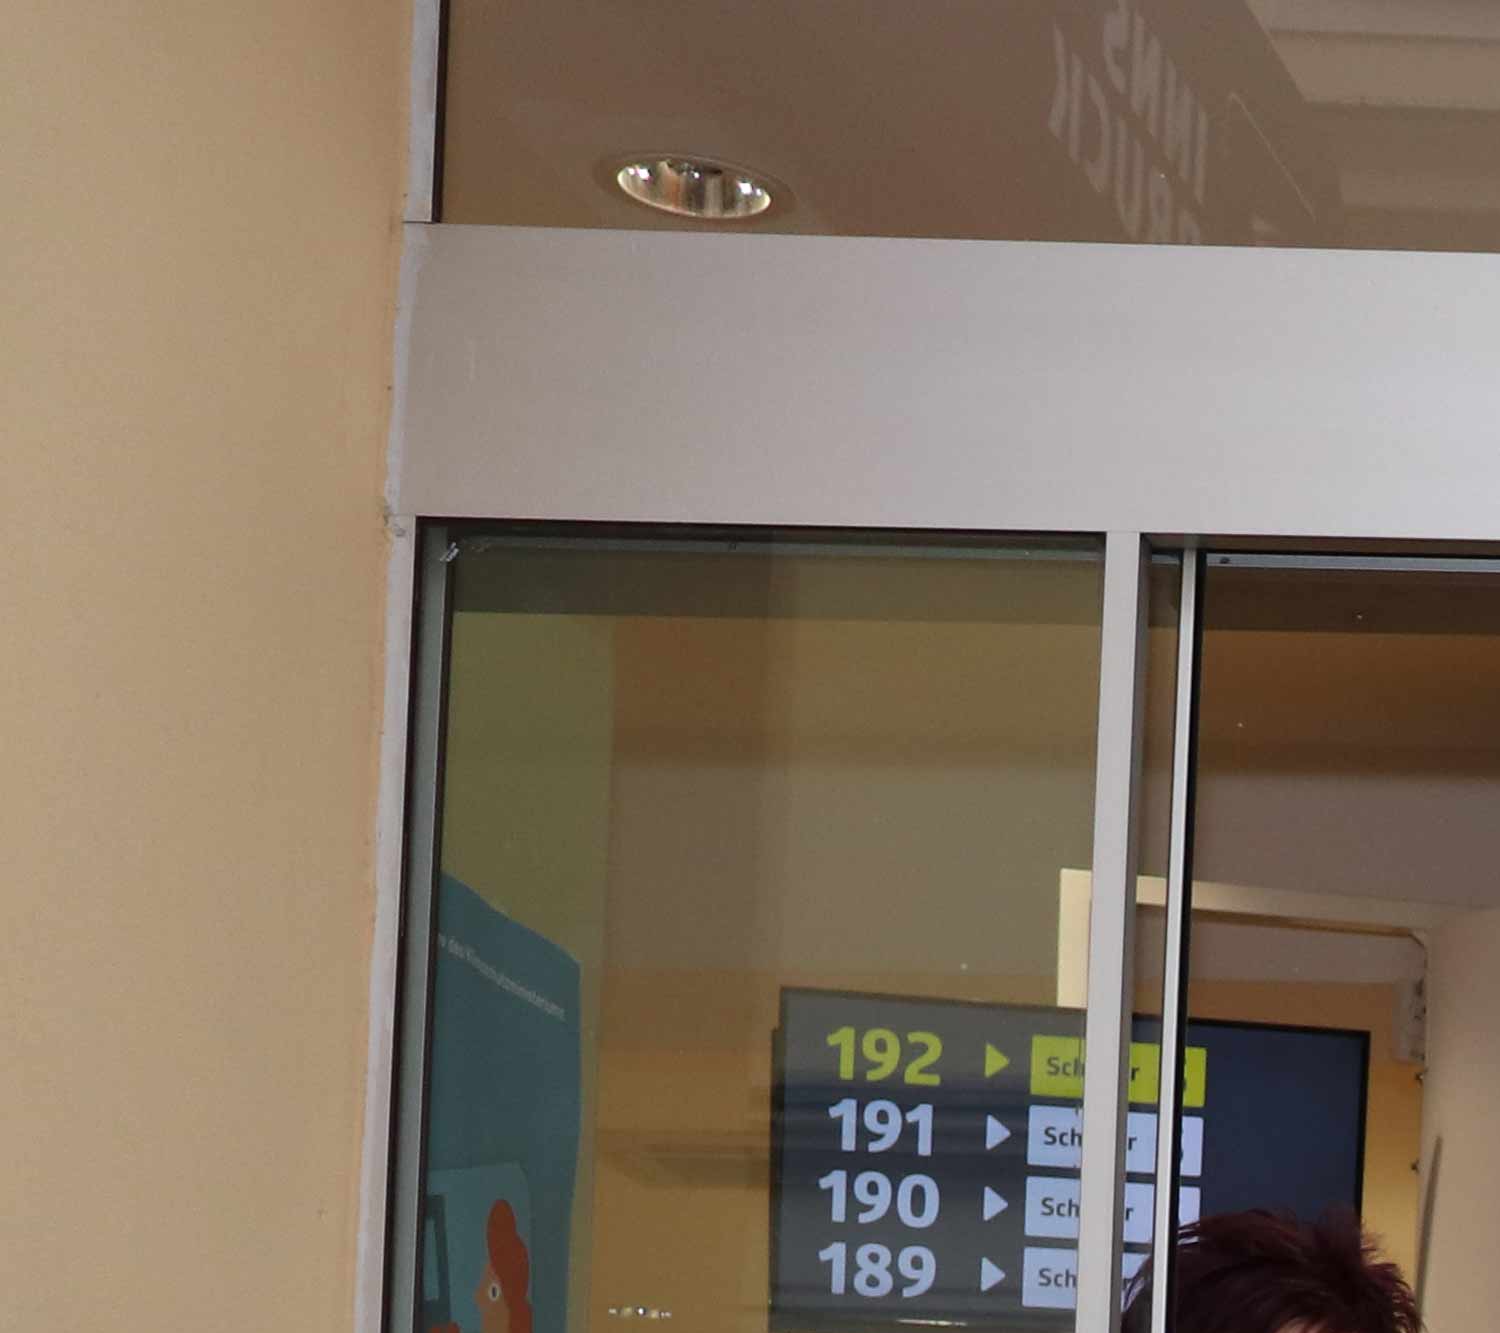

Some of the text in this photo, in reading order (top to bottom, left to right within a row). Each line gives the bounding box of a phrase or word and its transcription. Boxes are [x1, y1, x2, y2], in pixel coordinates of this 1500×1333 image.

[826, 1026, 943, 1086] 192
[828, 1098, 934, 1156] 191
[818, 1170, 940, 1228] 190
[818, 1242, 937, 1298] 189
